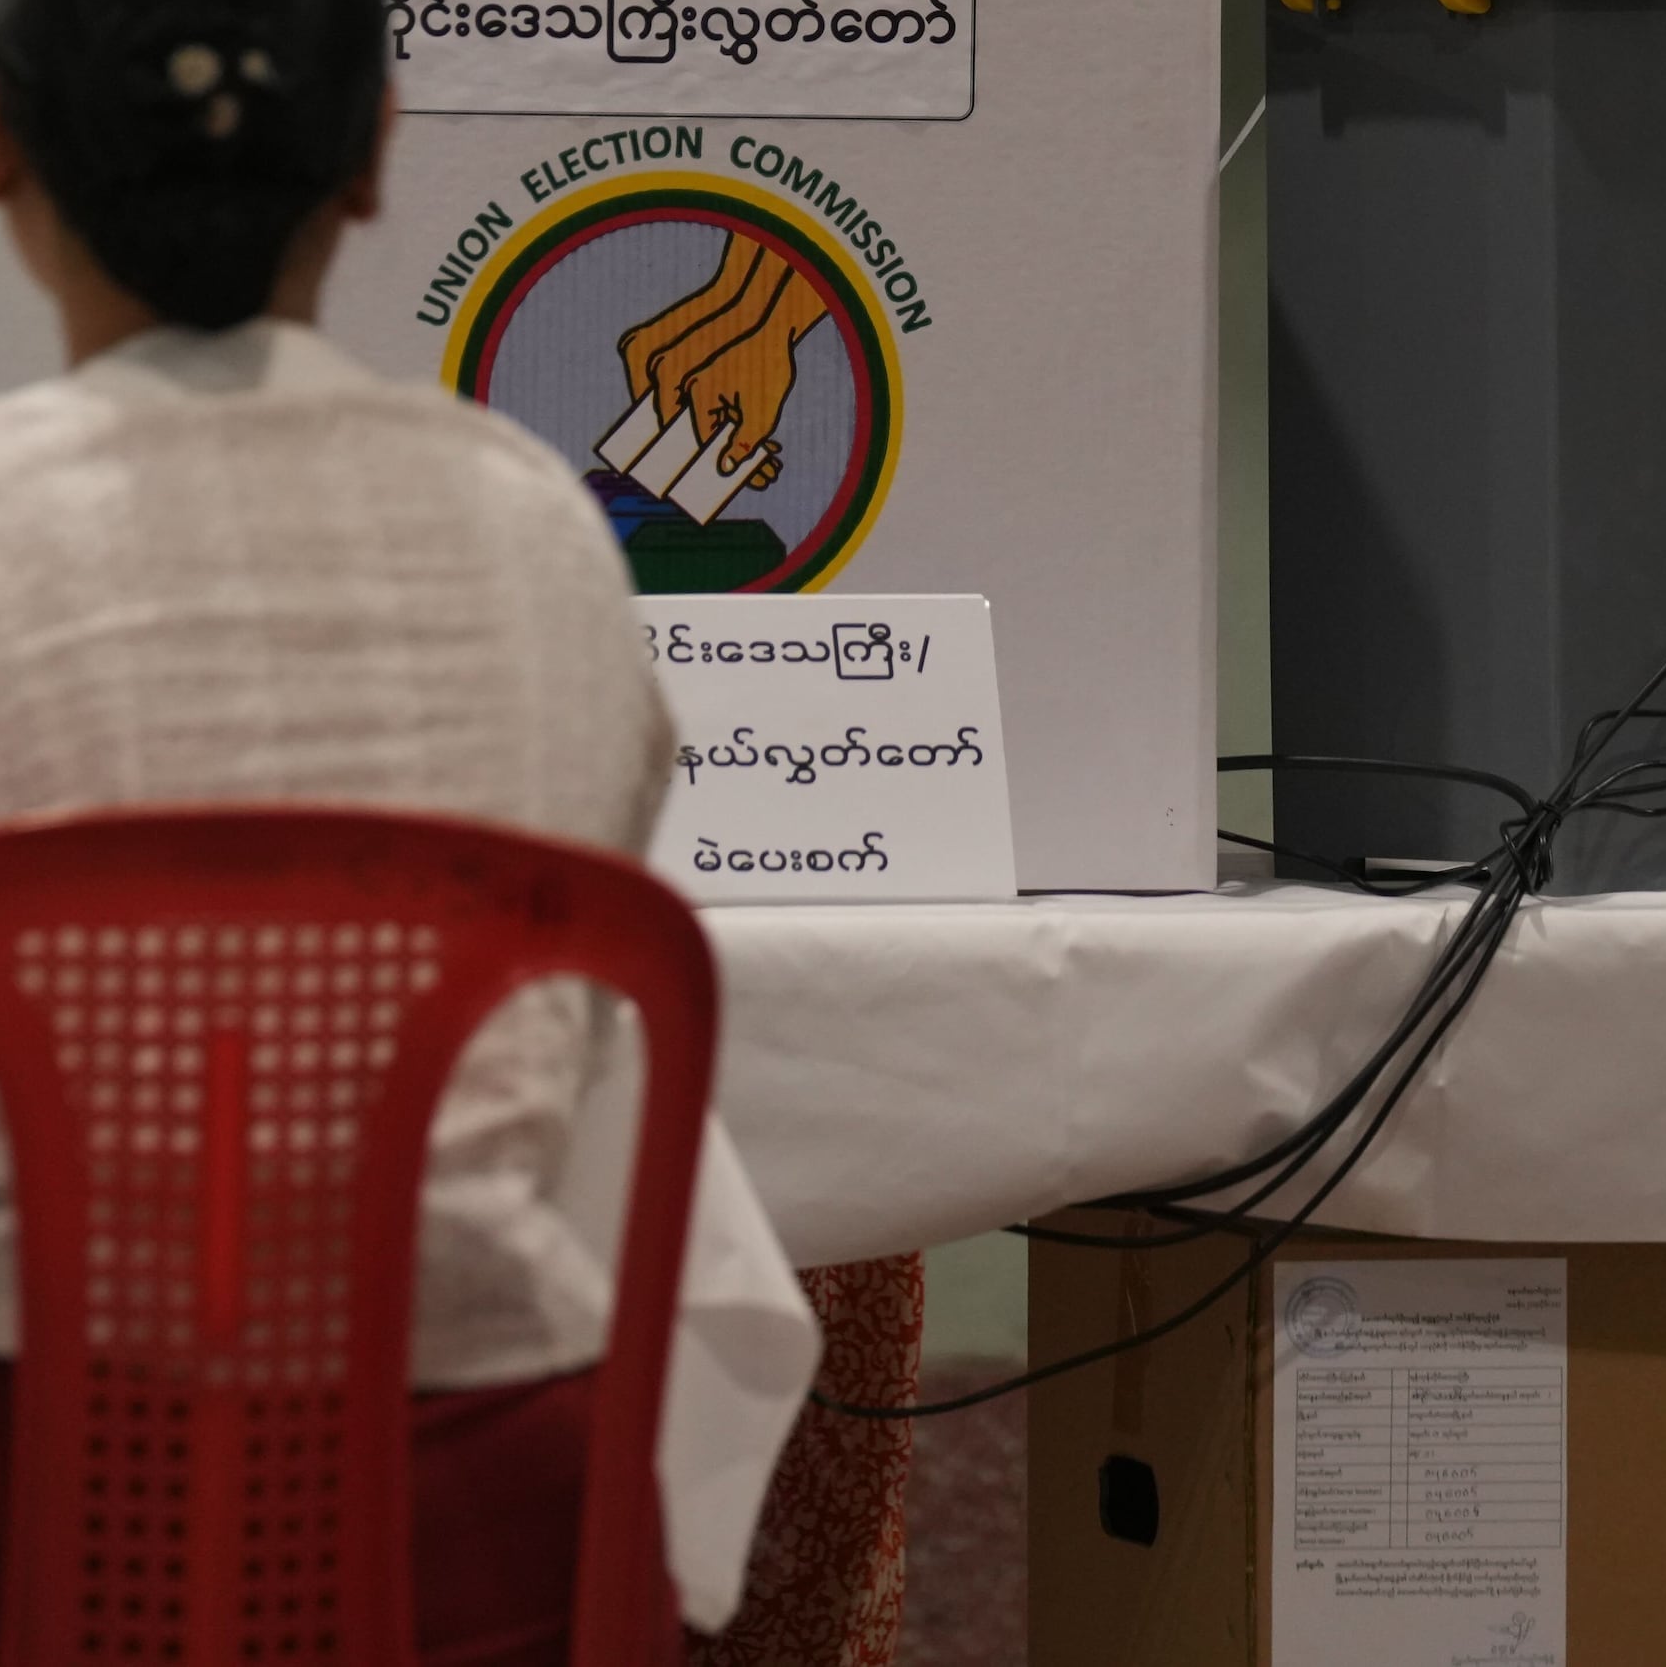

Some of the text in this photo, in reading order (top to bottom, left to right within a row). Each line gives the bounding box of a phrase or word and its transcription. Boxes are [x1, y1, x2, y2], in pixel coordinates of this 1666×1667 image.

[416, 125, 933, 335] UNION ELECTION COMMISSION
[643, 622, 931, 681] င်းဒေသကြီး/
[693, 831, 889, 873] မဲပေးစက်
